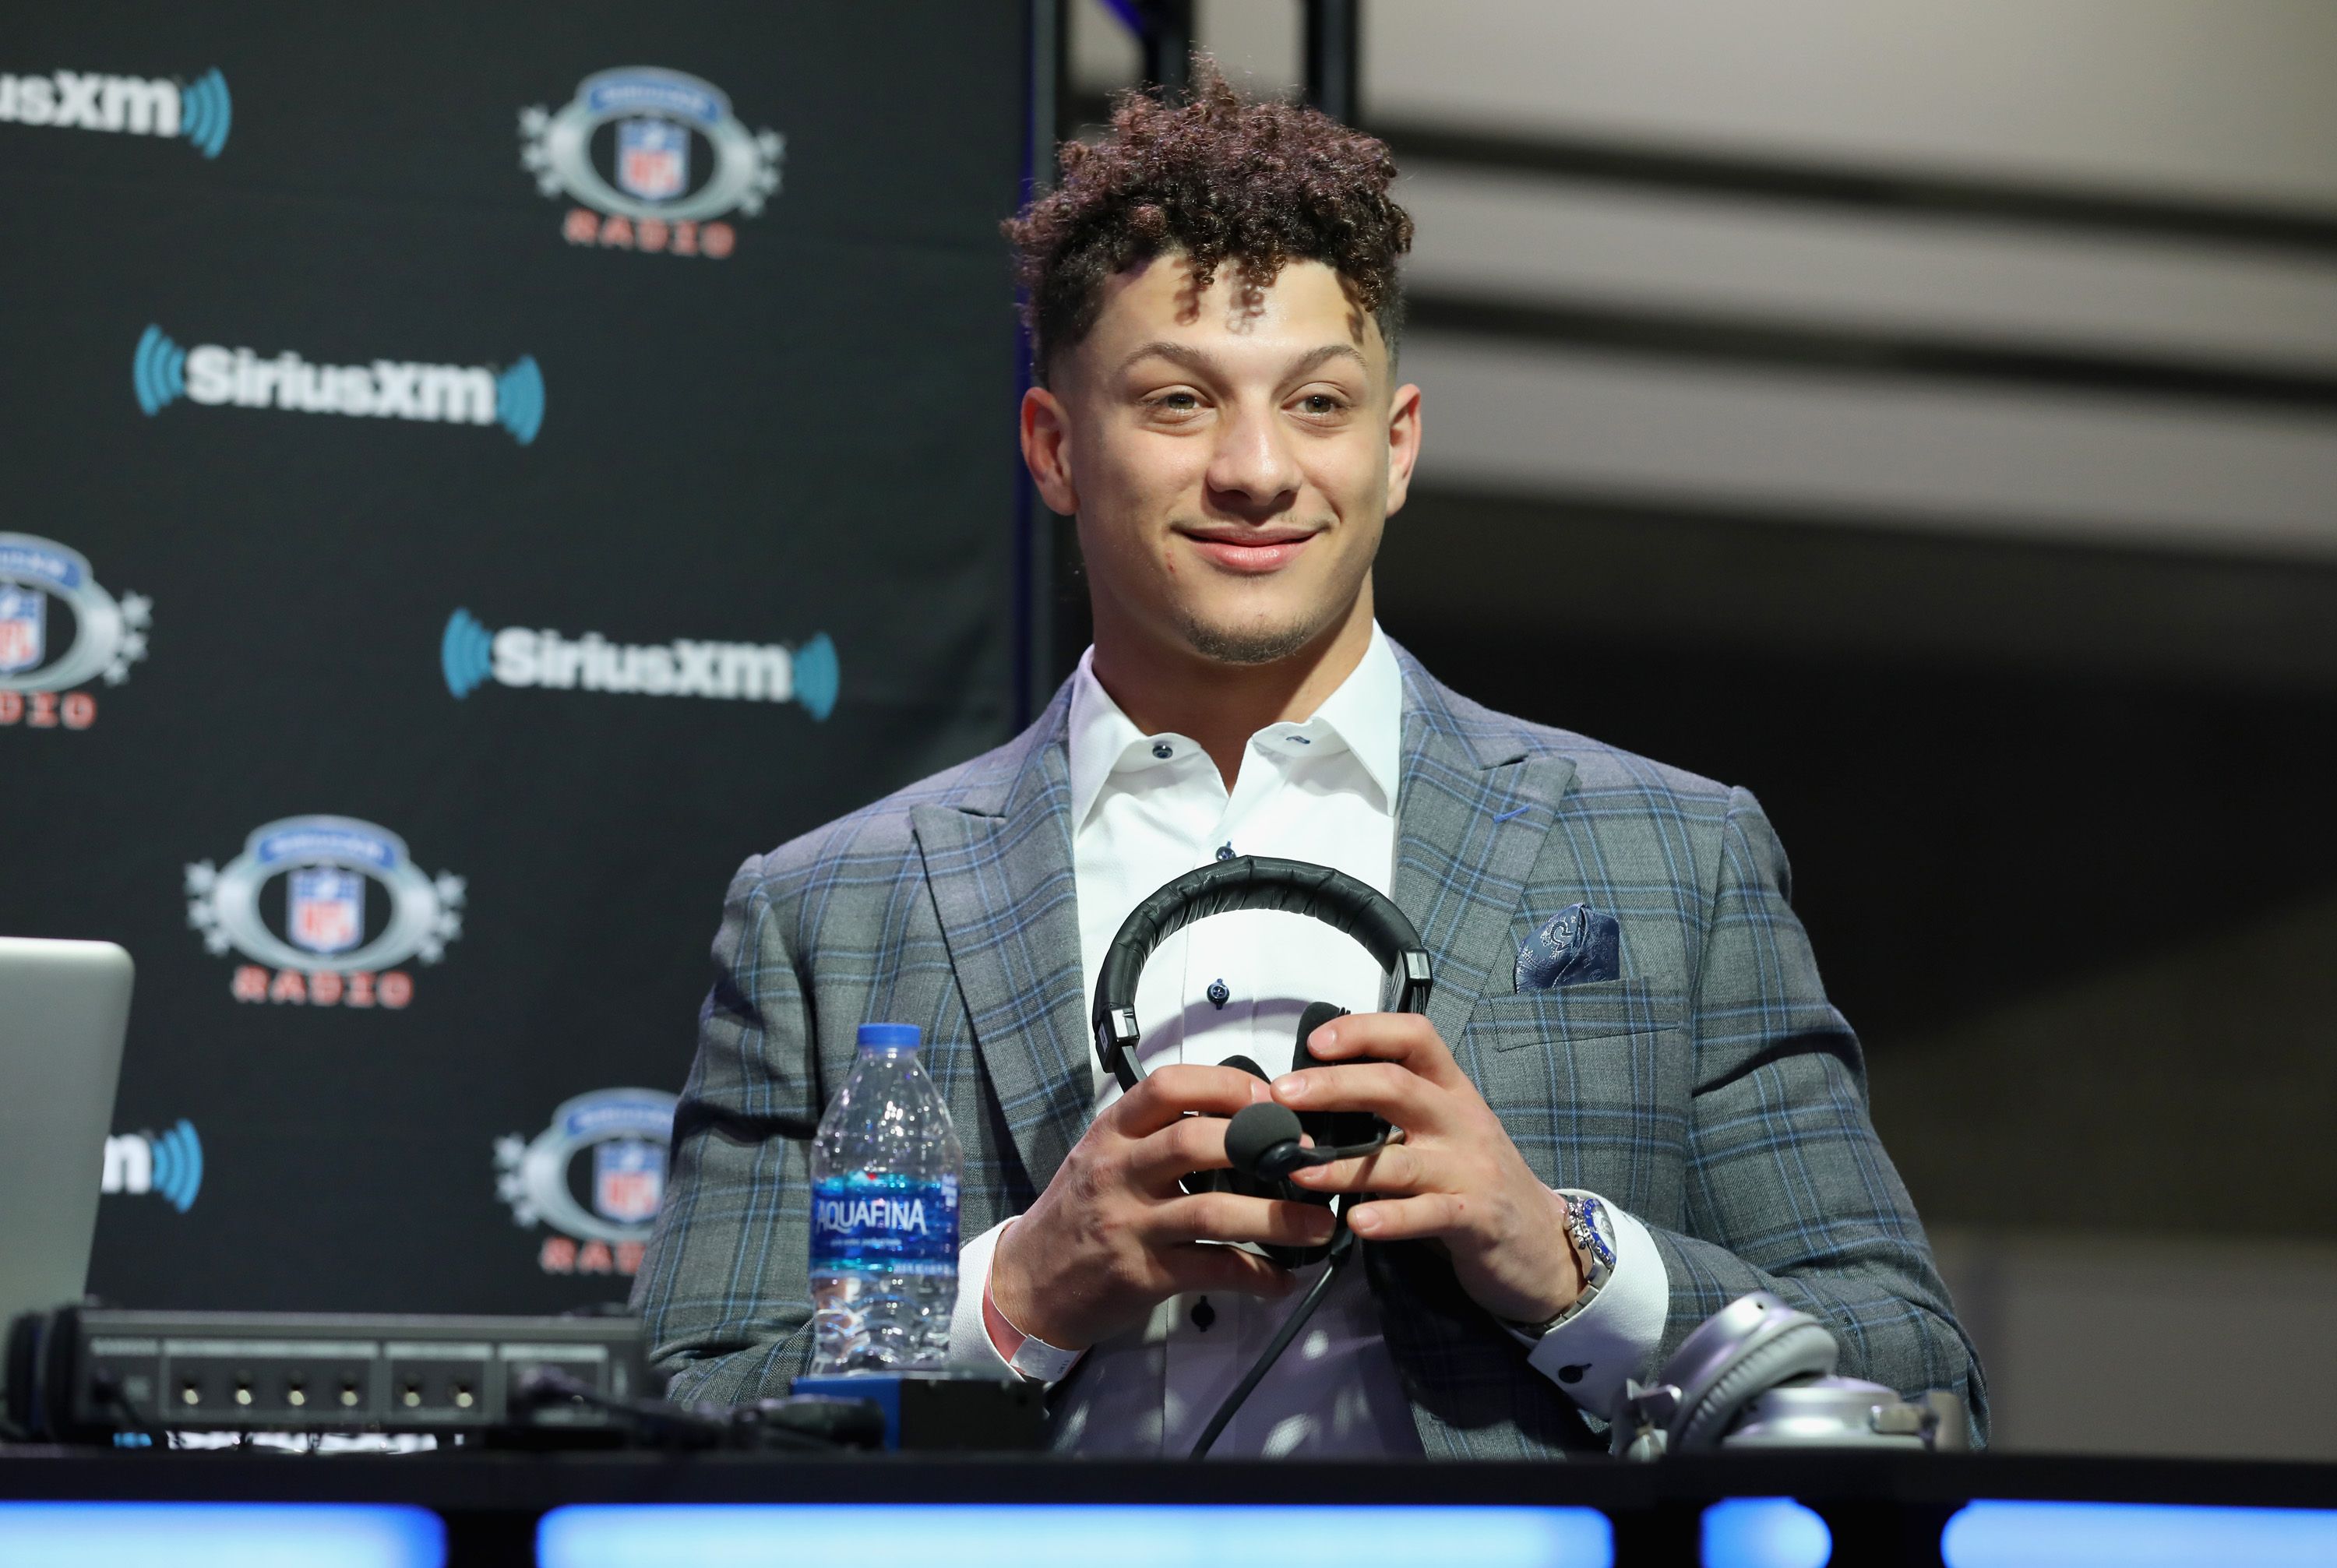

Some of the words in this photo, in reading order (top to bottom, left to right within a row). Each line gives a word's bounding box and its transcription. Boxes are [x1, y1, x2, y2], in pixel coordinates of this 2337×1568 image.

[563, 208, 735, 257] RADIO
[232, 965, 414, 1008] RADIO
[816, 1197, 932, 1235] AQUAFINA
